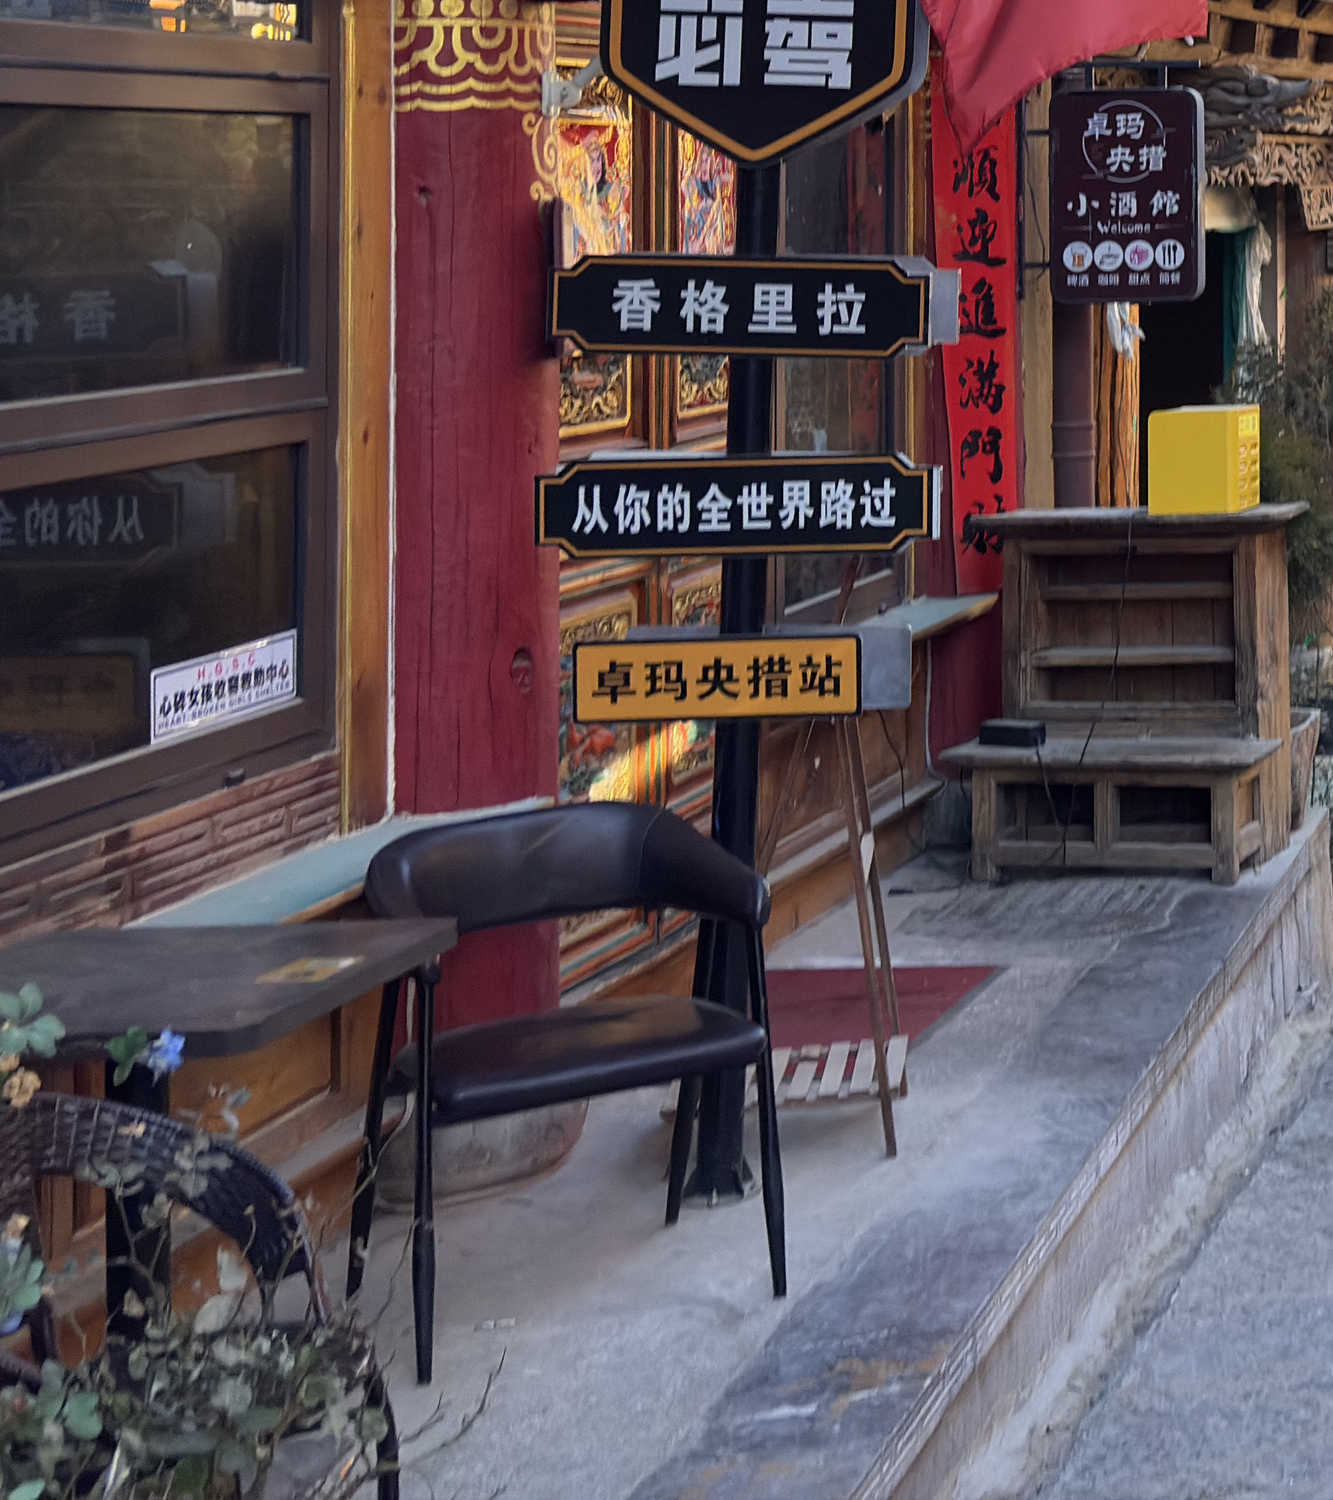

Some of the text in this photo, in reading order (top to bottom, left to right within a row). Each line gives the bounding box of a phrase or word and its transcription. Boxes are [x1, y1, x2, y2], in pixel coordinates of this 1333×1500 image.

[655, 15, 854, 90] 必驾
[1084, 112, 1145, 141] 卓玛
[1106, 145, 1166, 172] 央措
[1066, 190, 1181, 218] 小酒馆
[1097, 220, 1151, 235] Welcome
[1128, 272, 1150, 286] 甜点
[612, 278, 867, 335] 香格里拉
[571, 477, 896, 536] 从你的全世界路过
[591, 654, 843, 705] 卓玛央措站
[191, 702, 226, 719] BROKEN
